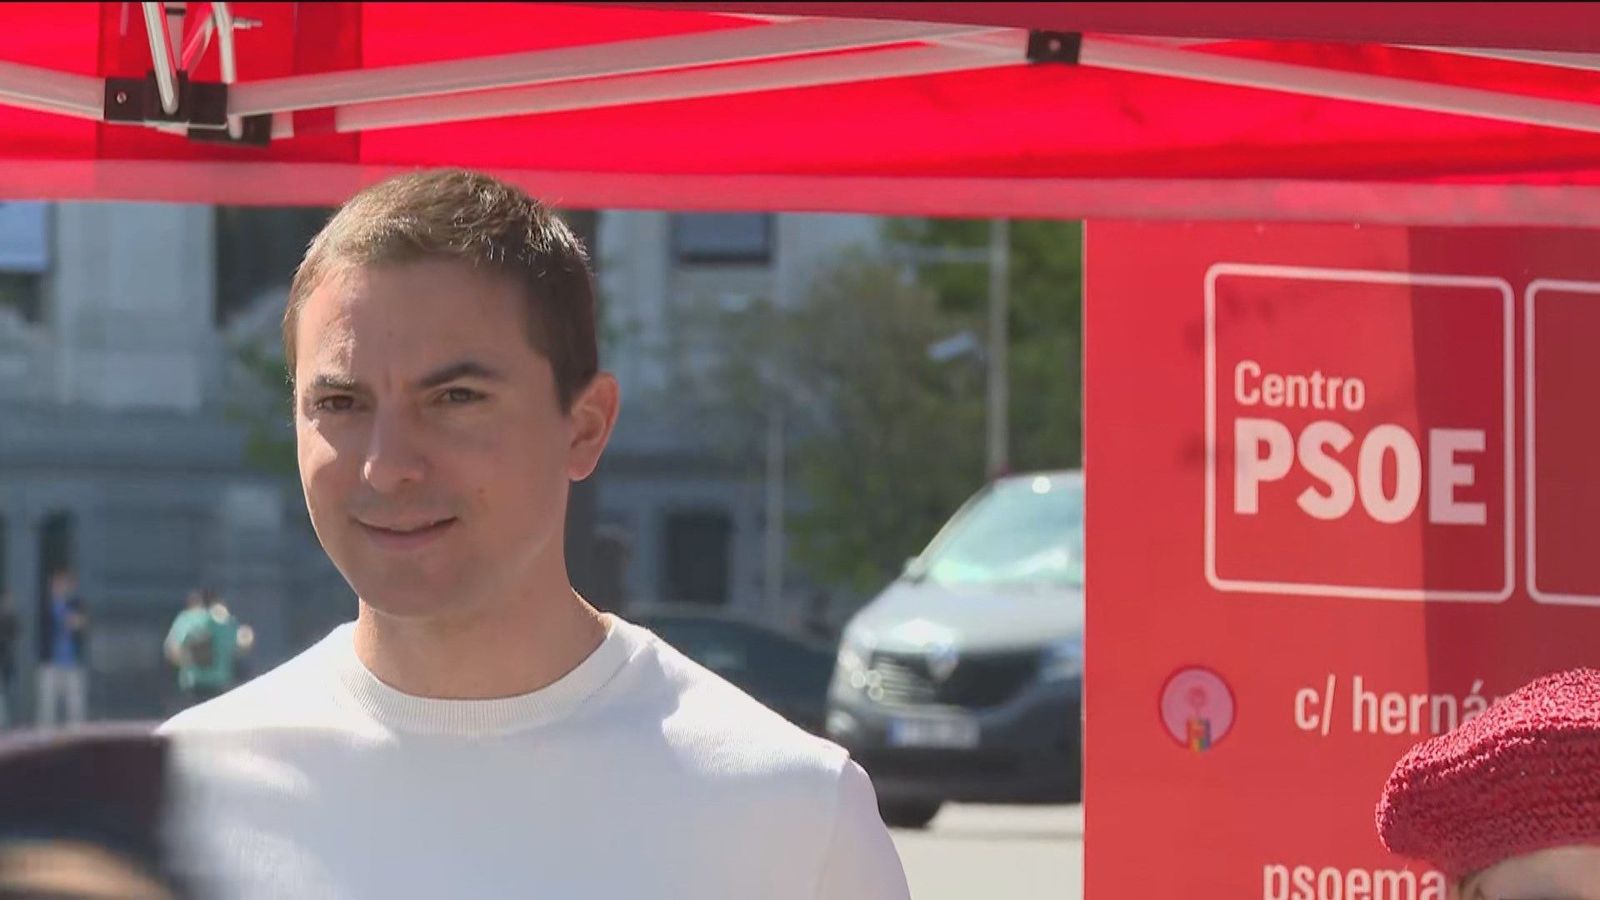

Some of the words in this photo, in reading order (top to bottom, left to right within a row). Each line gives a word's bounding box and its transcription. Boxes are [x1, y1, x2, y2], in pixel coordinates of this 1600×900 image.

[1234, 360, 1365, 412] Centro
[1234, 417, 1487, 525] PSOE
[1294, 673, 1336, 736] c/
[1352, 675, 1503, 735] herná
